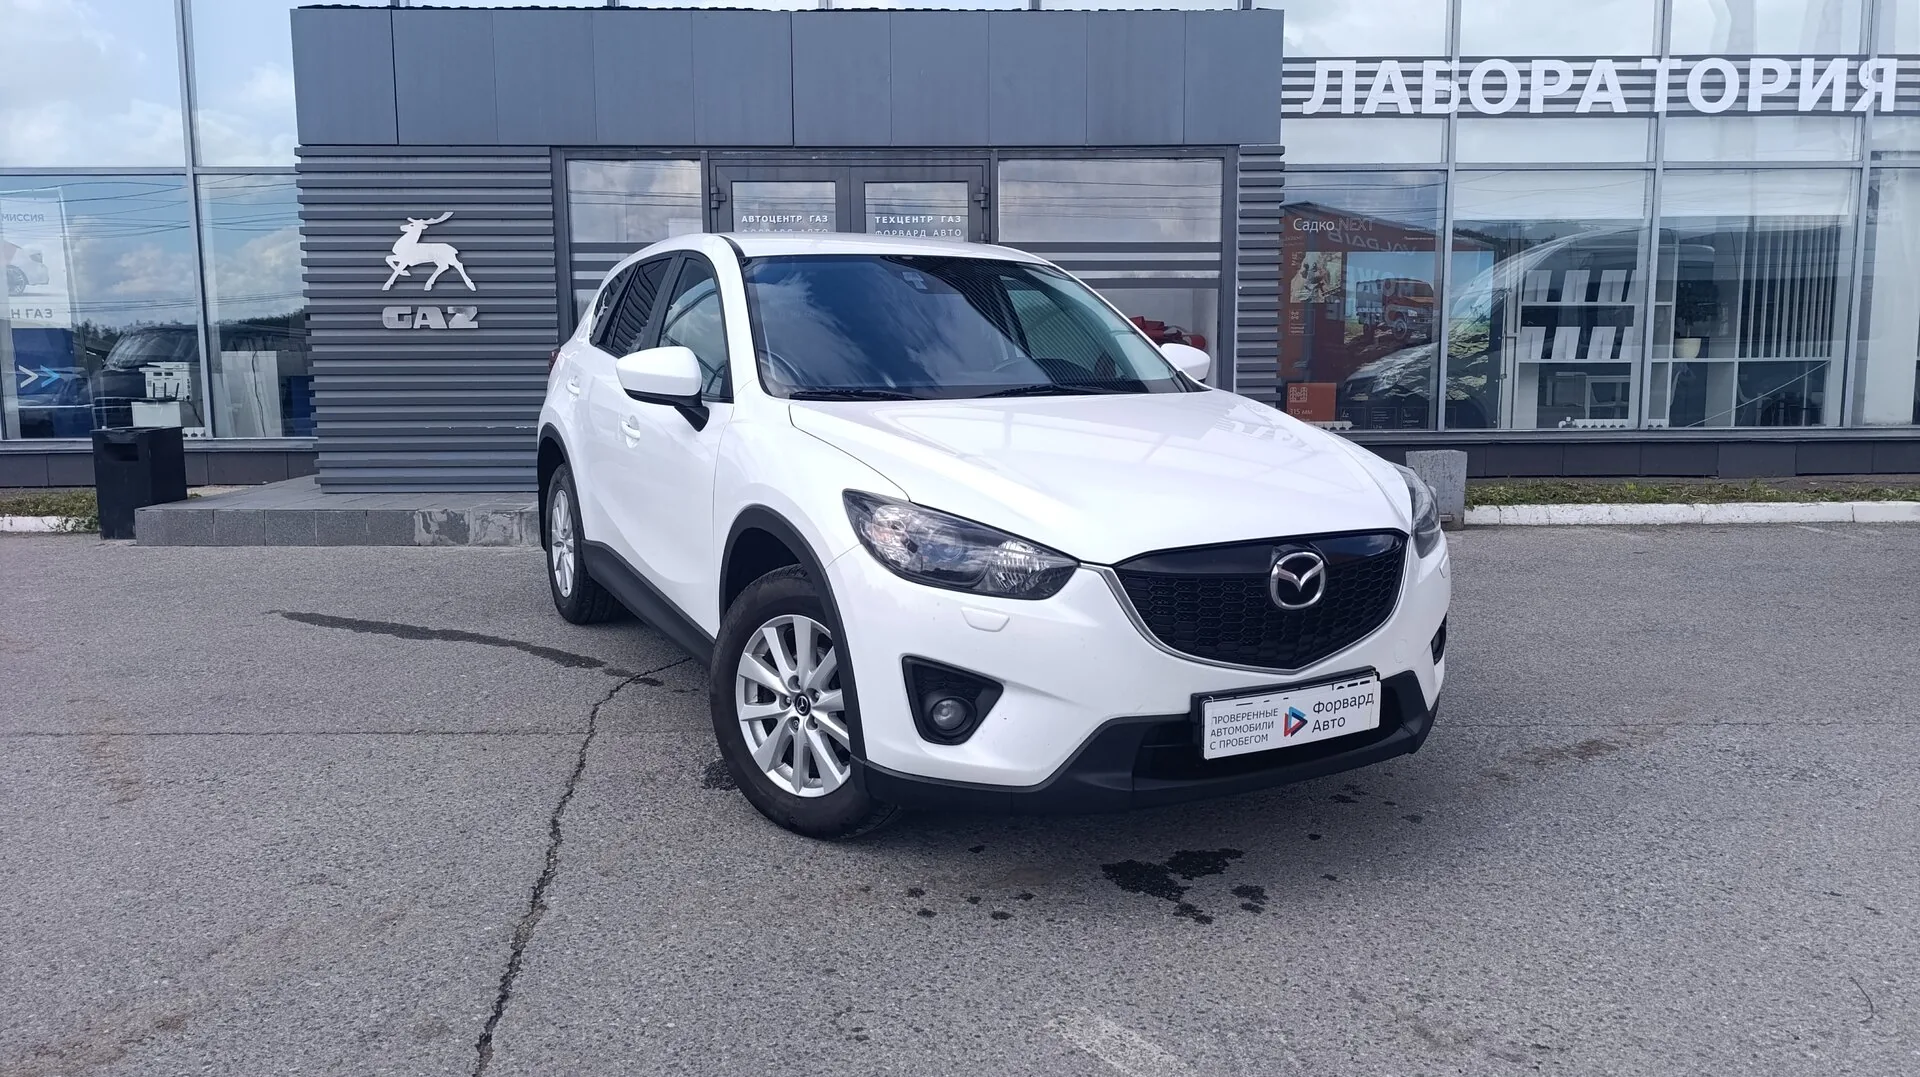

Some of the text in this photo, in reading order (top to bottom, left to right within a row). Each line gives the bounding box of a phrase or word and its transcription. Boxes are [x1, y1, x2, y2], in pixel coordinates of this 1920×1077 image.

[1302, 57, 1898, 115] ЛАБОРАТОРИЯ
[741, 215, 828, 224] АВТОЦЕНТР ГАЗ
[875, 215, 961, 224] ТЕХЦЕНТР ГАЗ
[1293, 217, 1375, 233] Садко NEXT
[875, 229, 962, 237] ФОРВАРД АВТО
[25, 308, 53, 318] ГАЗ
[382, 306, 479, 329] GAZ
[1312, 692, 1375, 715] Форвард
[1211, 708, 1279, 725] ПРОВЕРЕННЫЕ
[1210, 721, 1275, 737] АВТОМОБИЛИ
[1312, 717, 1346, 733] Авто
[1209, 733, 1269, 751] С ПРОБЕГОМ
